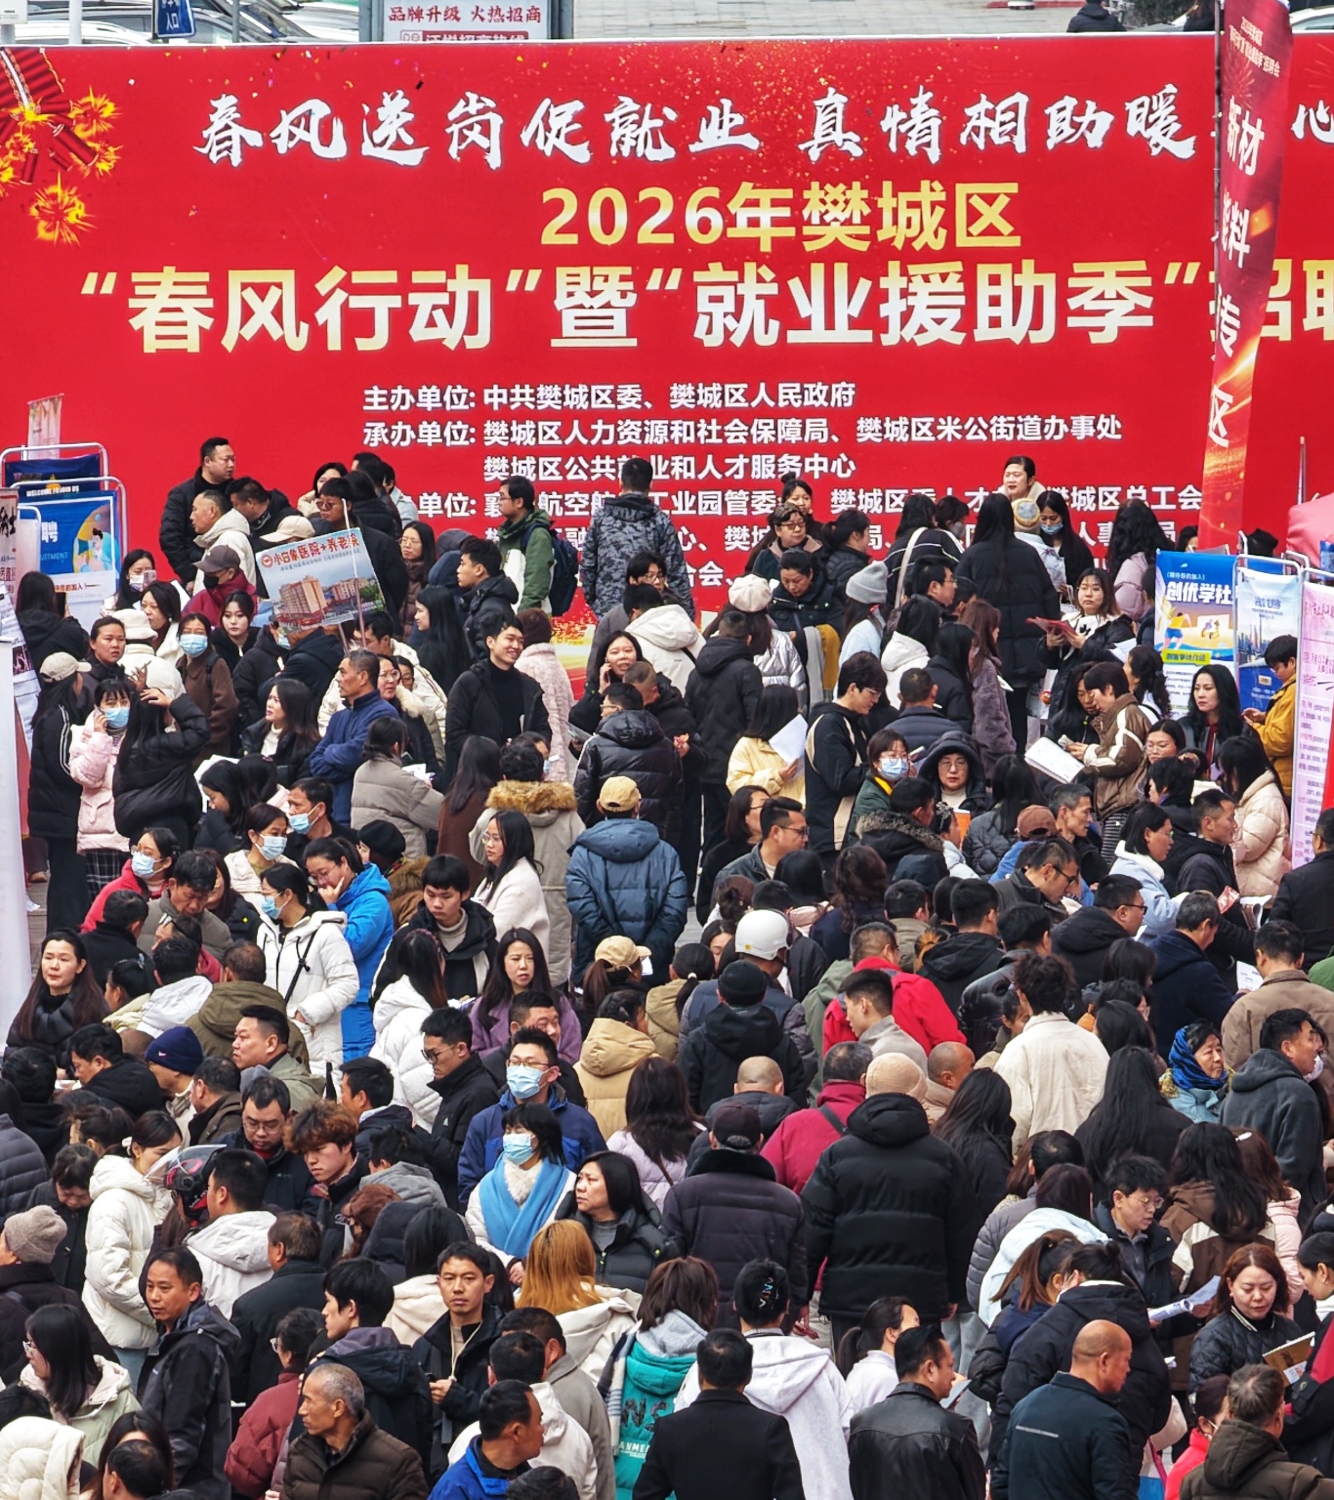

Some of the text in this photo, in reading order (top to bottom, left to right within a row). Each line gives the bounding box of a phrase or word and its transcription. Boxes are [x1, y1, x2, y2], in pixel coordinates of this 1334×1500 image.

[388, 5, 542, 24] 品牌升级 火热招商
[193, 90, 762, 170] 春风送岗促就业
[539, 180, 1022, 253] 2026年樊城区
[483, 452, 857, 482] 樊城区公共业和人才服务中心
